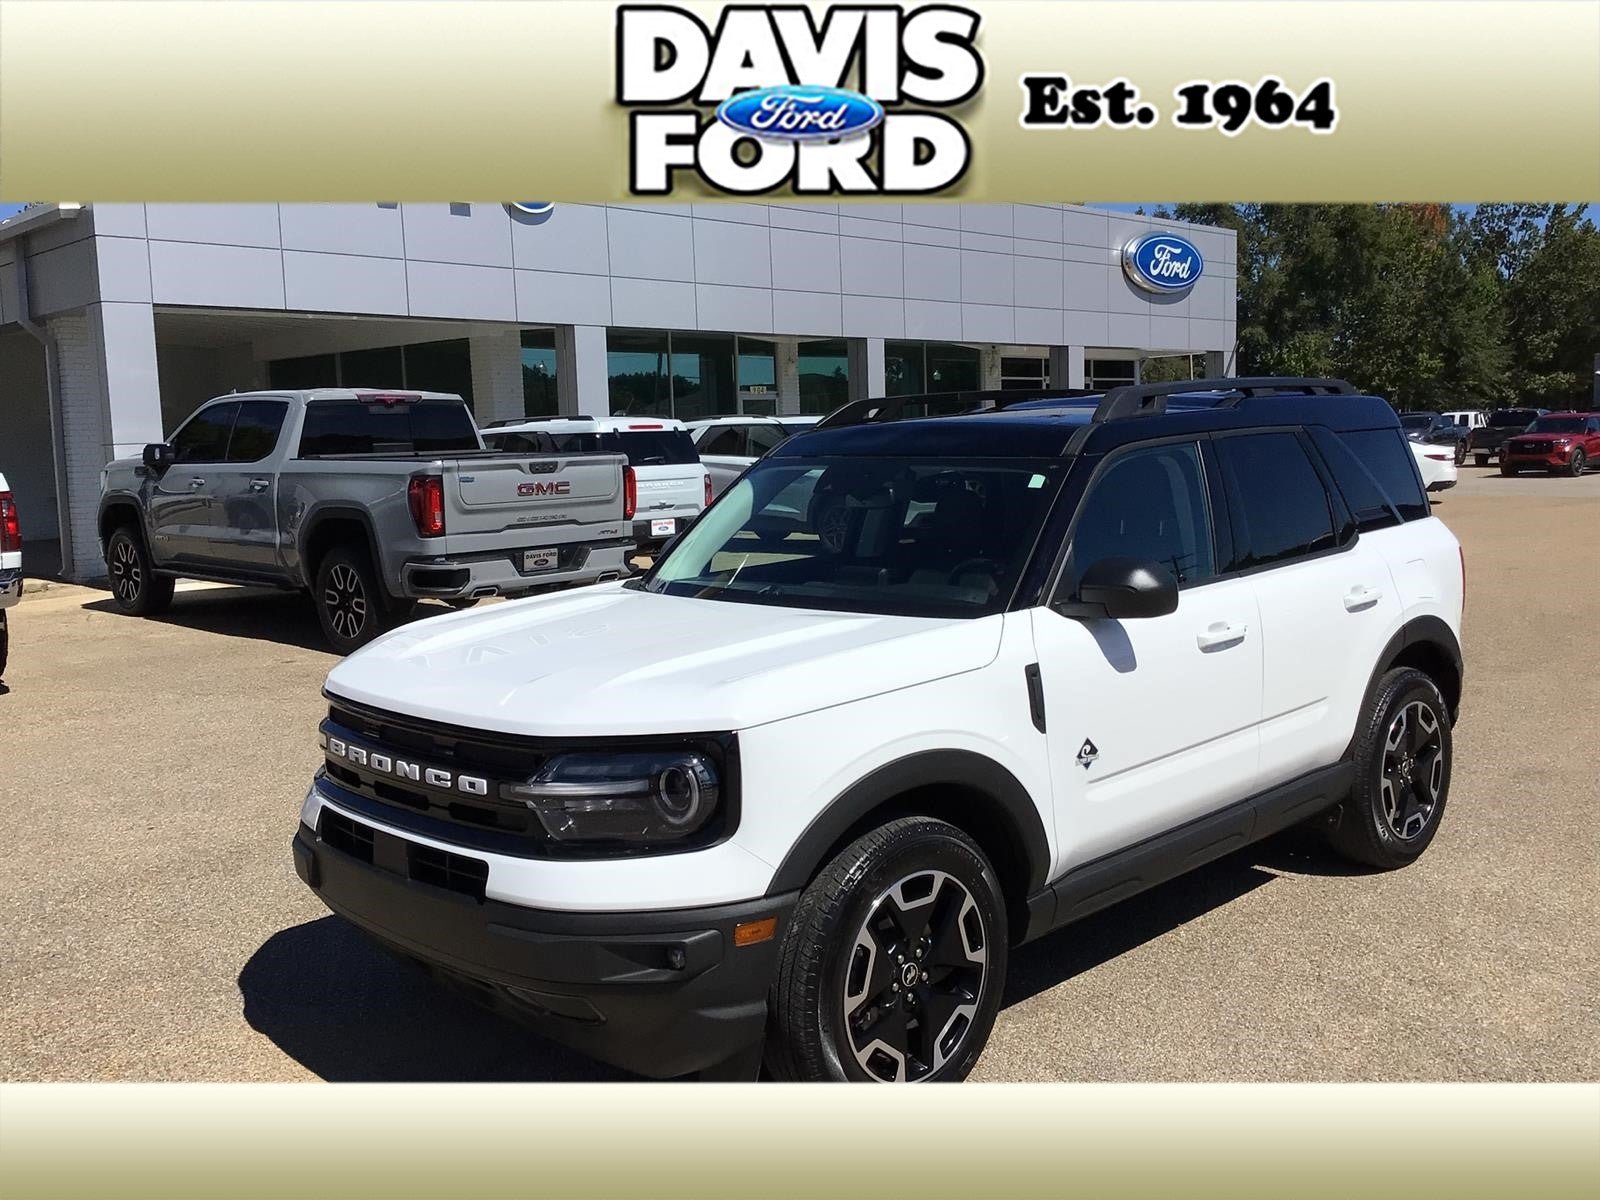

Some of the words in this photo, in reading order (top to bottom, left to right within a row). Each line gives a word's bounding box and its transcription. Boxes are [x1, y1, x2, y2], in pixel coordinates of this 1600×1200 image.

[1150, 244, 1192, 279] Ford
[517, 480, 571, 497] GMC
[329, 737, 488, 796] BRONCO
